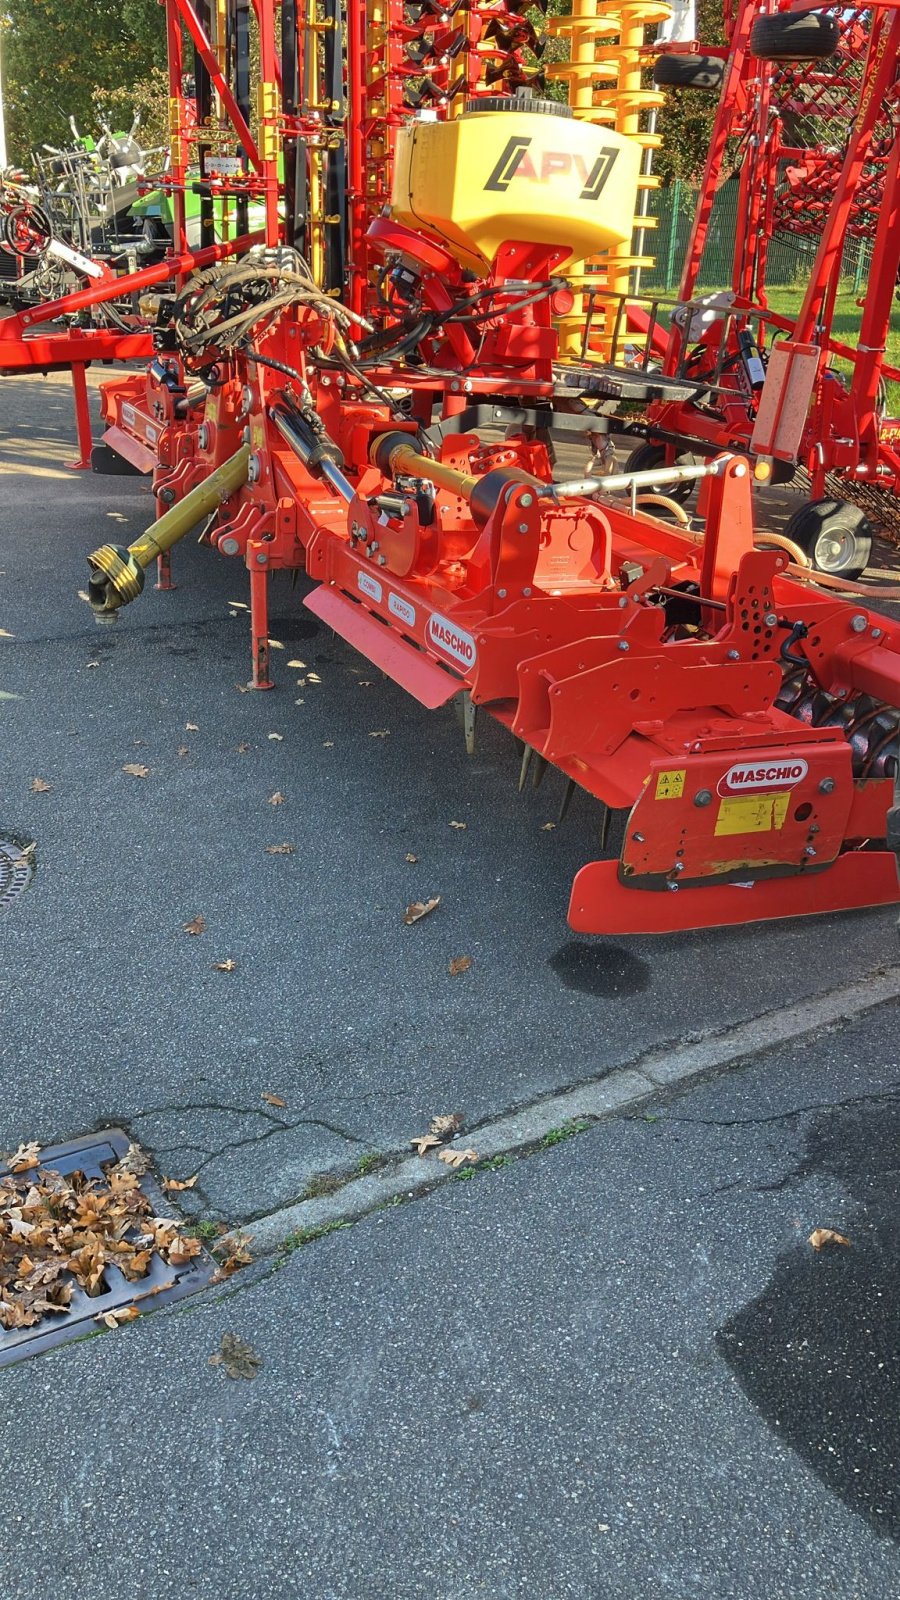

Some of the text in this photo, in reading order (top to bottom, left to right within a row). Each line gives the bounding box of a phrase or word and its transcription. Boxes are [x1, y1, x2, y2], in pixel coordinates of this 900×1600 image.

[503, 148, 605, 188] APV
[431, 620, 473, 661] MASCHIO
[730, 766, 803, 784] MASCHIO
